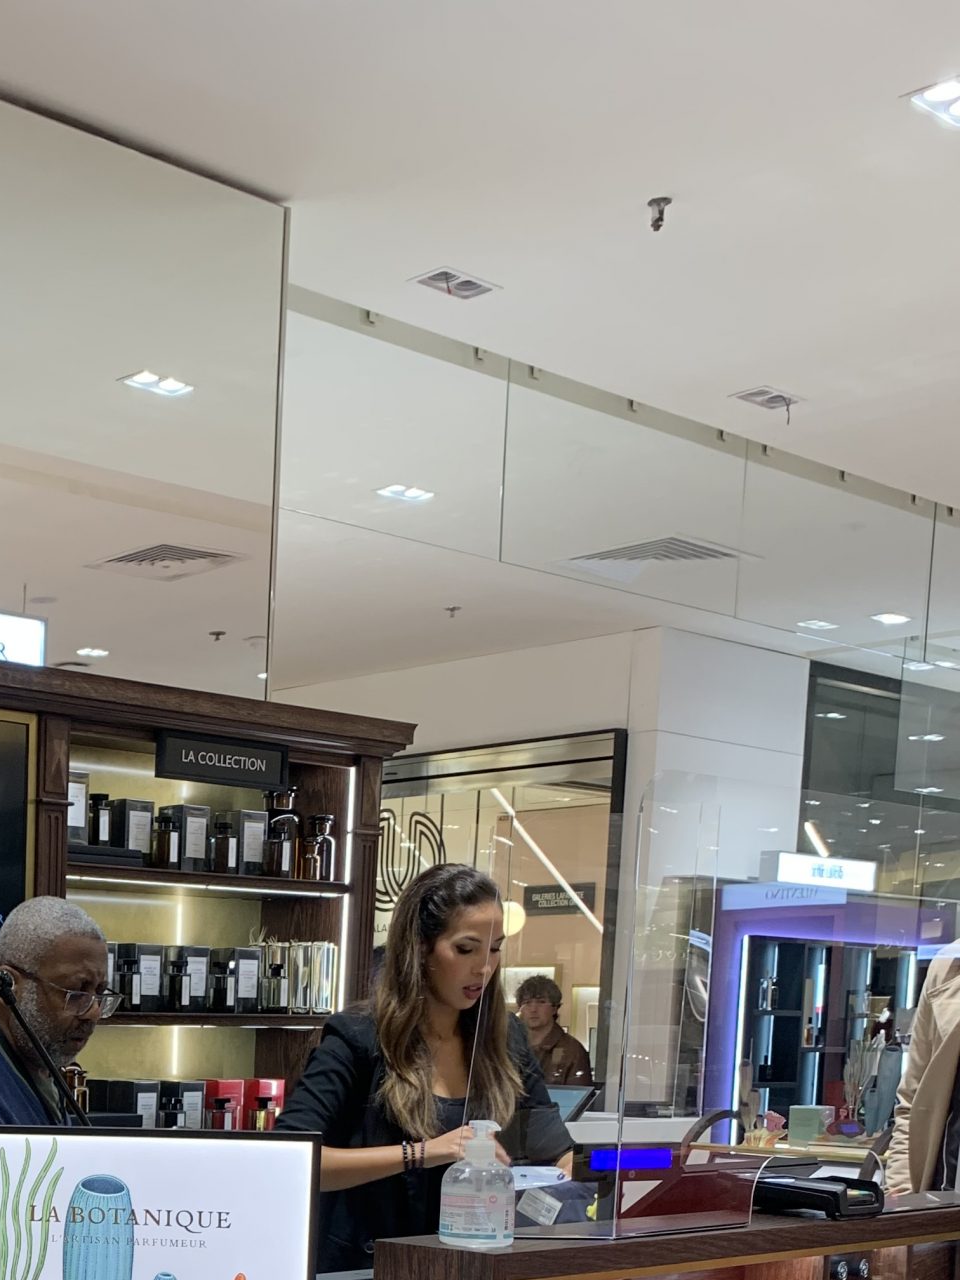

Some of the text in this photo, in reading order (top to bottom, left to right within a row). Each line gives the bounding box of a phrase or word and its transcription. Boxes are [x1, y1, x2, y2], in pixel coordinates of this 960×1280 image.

[181, 749, 266, 772] LA COLLECTION
[538, 899, 569, 908] COLLECTION
[29, 1204, 232, 1234] LA BOTANIQUE
[51, 1234, 208, 1249] L'ARTISAN PARFUMEUR
